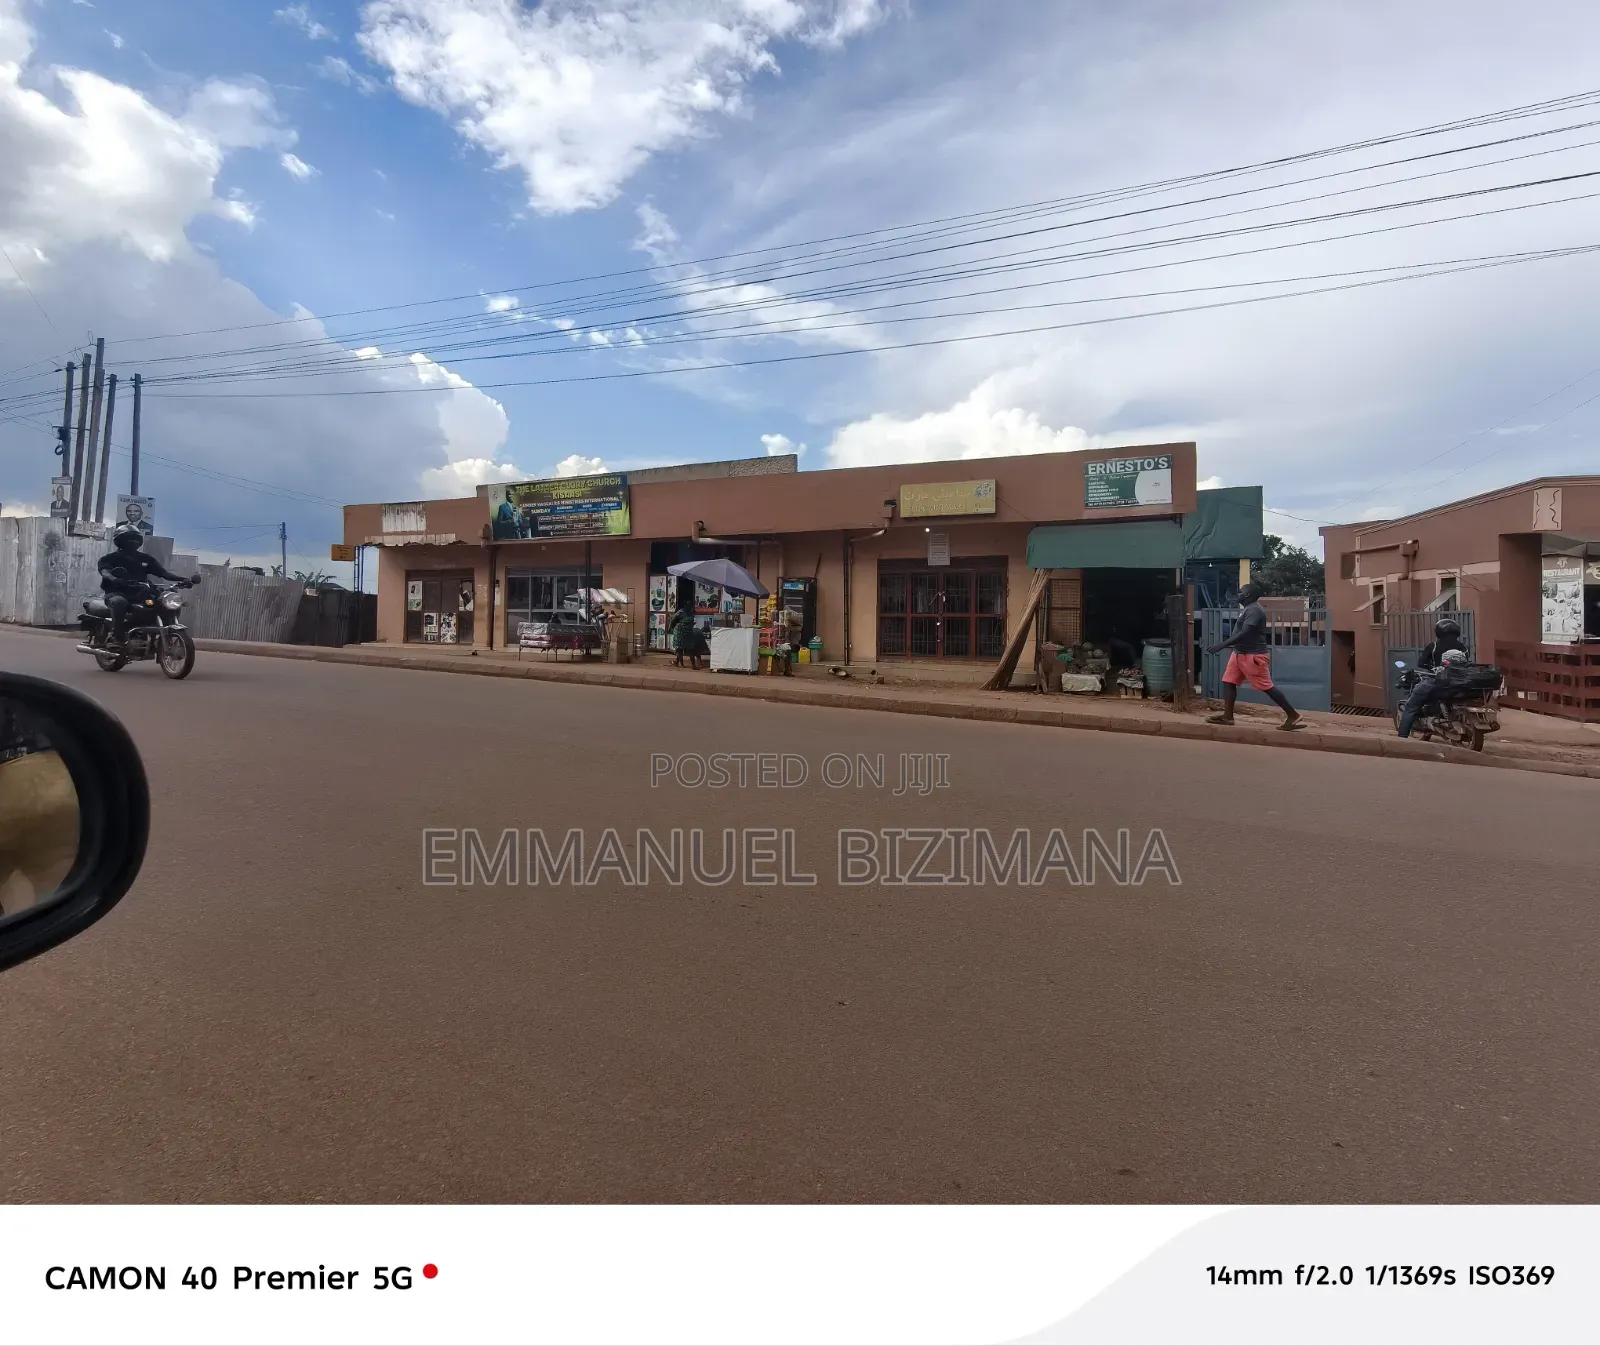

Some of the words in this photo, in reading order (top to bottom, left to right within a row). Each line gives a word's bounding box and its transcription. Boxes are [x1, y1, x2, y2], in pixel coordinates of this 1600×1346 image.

[1088, 457, 1168, 475] ERNESTO'S
[515, 485, 530, 493] THE
[587, 477, 621, 486] CHURCH
[585, 496, 619, 504] INTERNATIONAL
[1543, 567, 1580, 577] RESTAURANT
